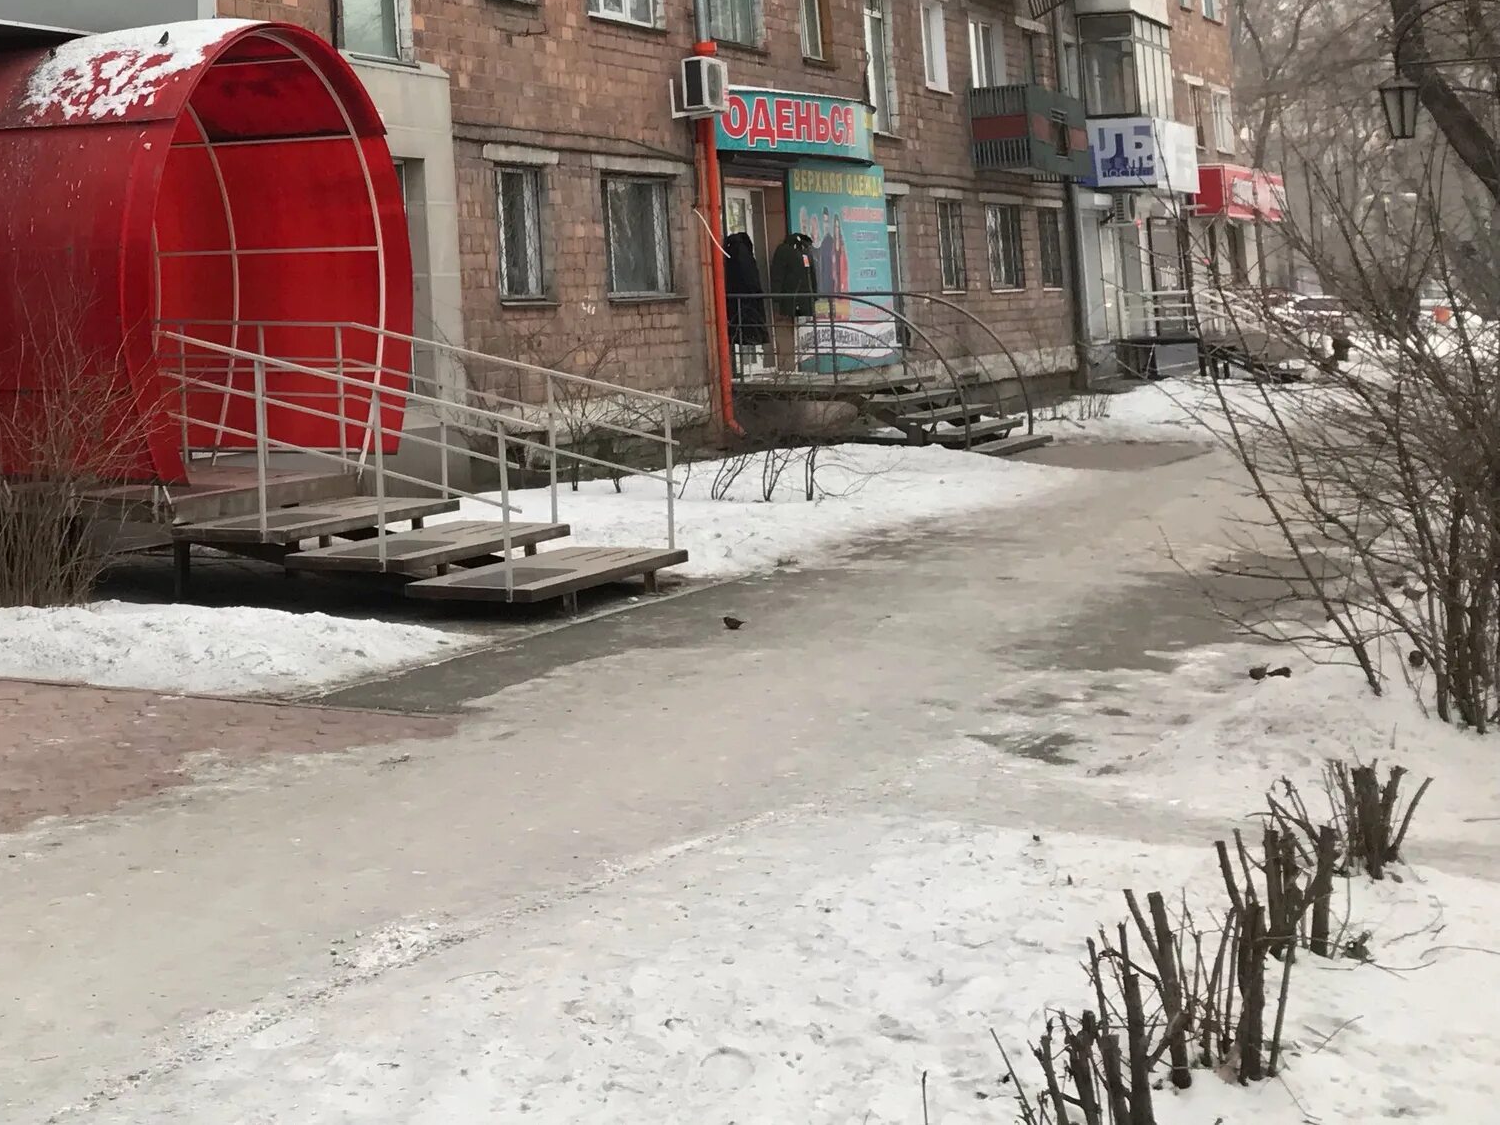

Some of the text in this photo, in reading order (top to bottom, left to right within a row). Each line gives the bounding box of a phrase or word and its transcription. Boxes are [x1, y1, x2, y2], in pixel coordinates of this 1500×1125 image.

[720, 94, 856, 148] ОДЕНЬСЯ
[793, 169, 883, 199] ВЕРХНЯЯ ОДЕЖДА
